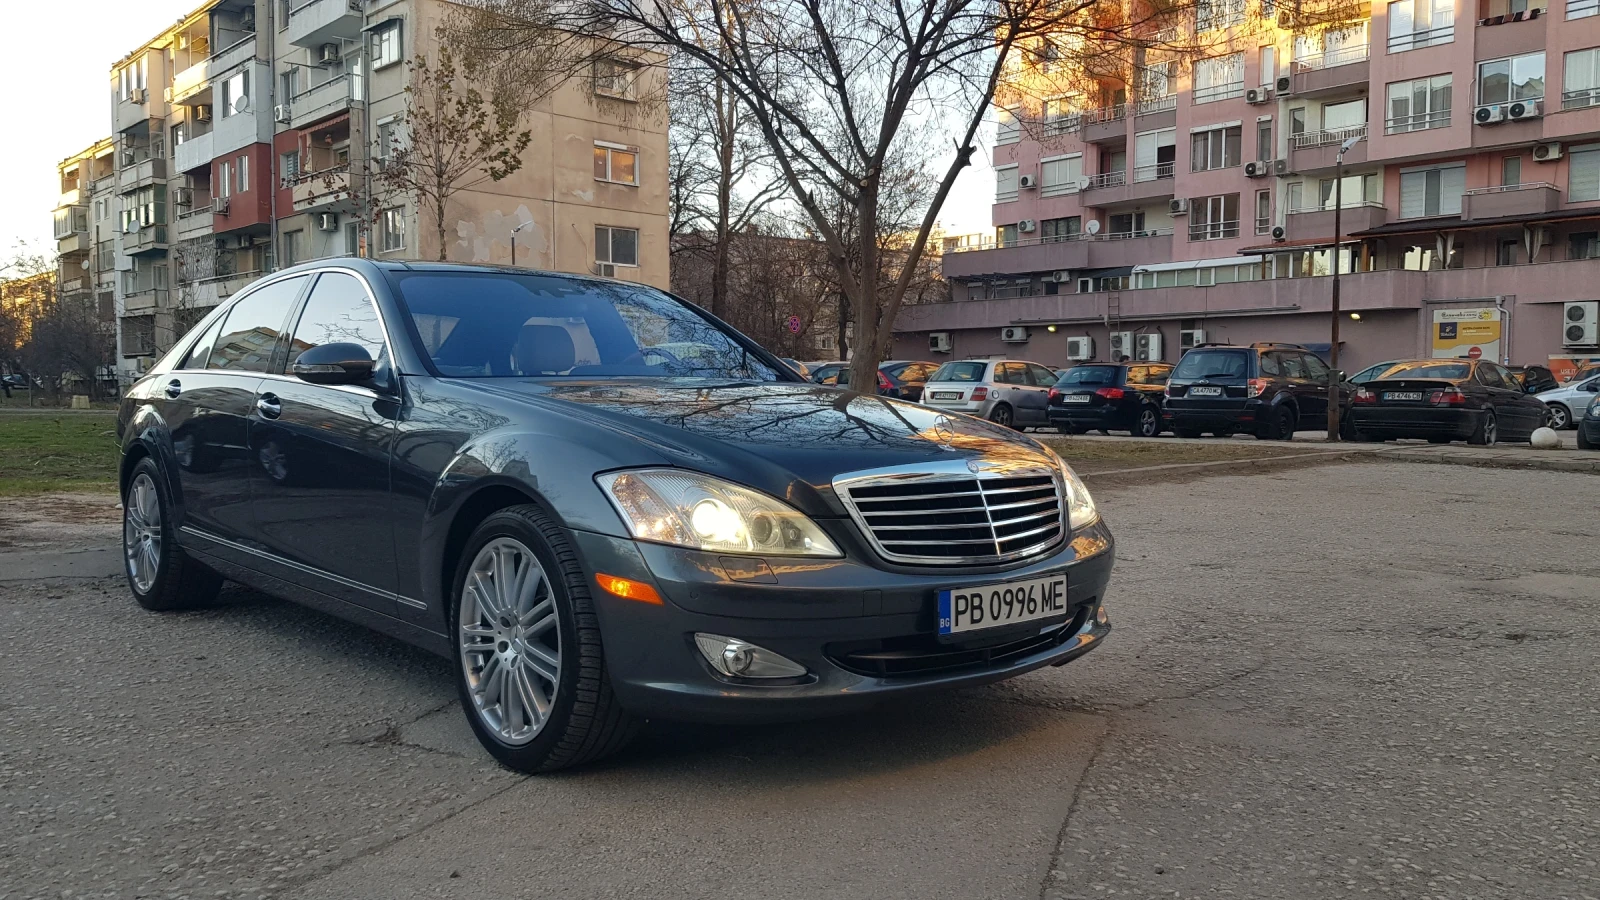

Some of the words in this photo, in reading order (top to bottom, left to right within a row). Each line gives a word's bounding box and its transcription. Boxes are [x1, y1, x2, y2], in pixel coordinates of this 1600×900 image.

[940, 617, 950, 628] BG
[954, 592, 984, 627] PB
[990, 584, 1037, 621] 0996
[1041, 580, 1064, 613] ME
